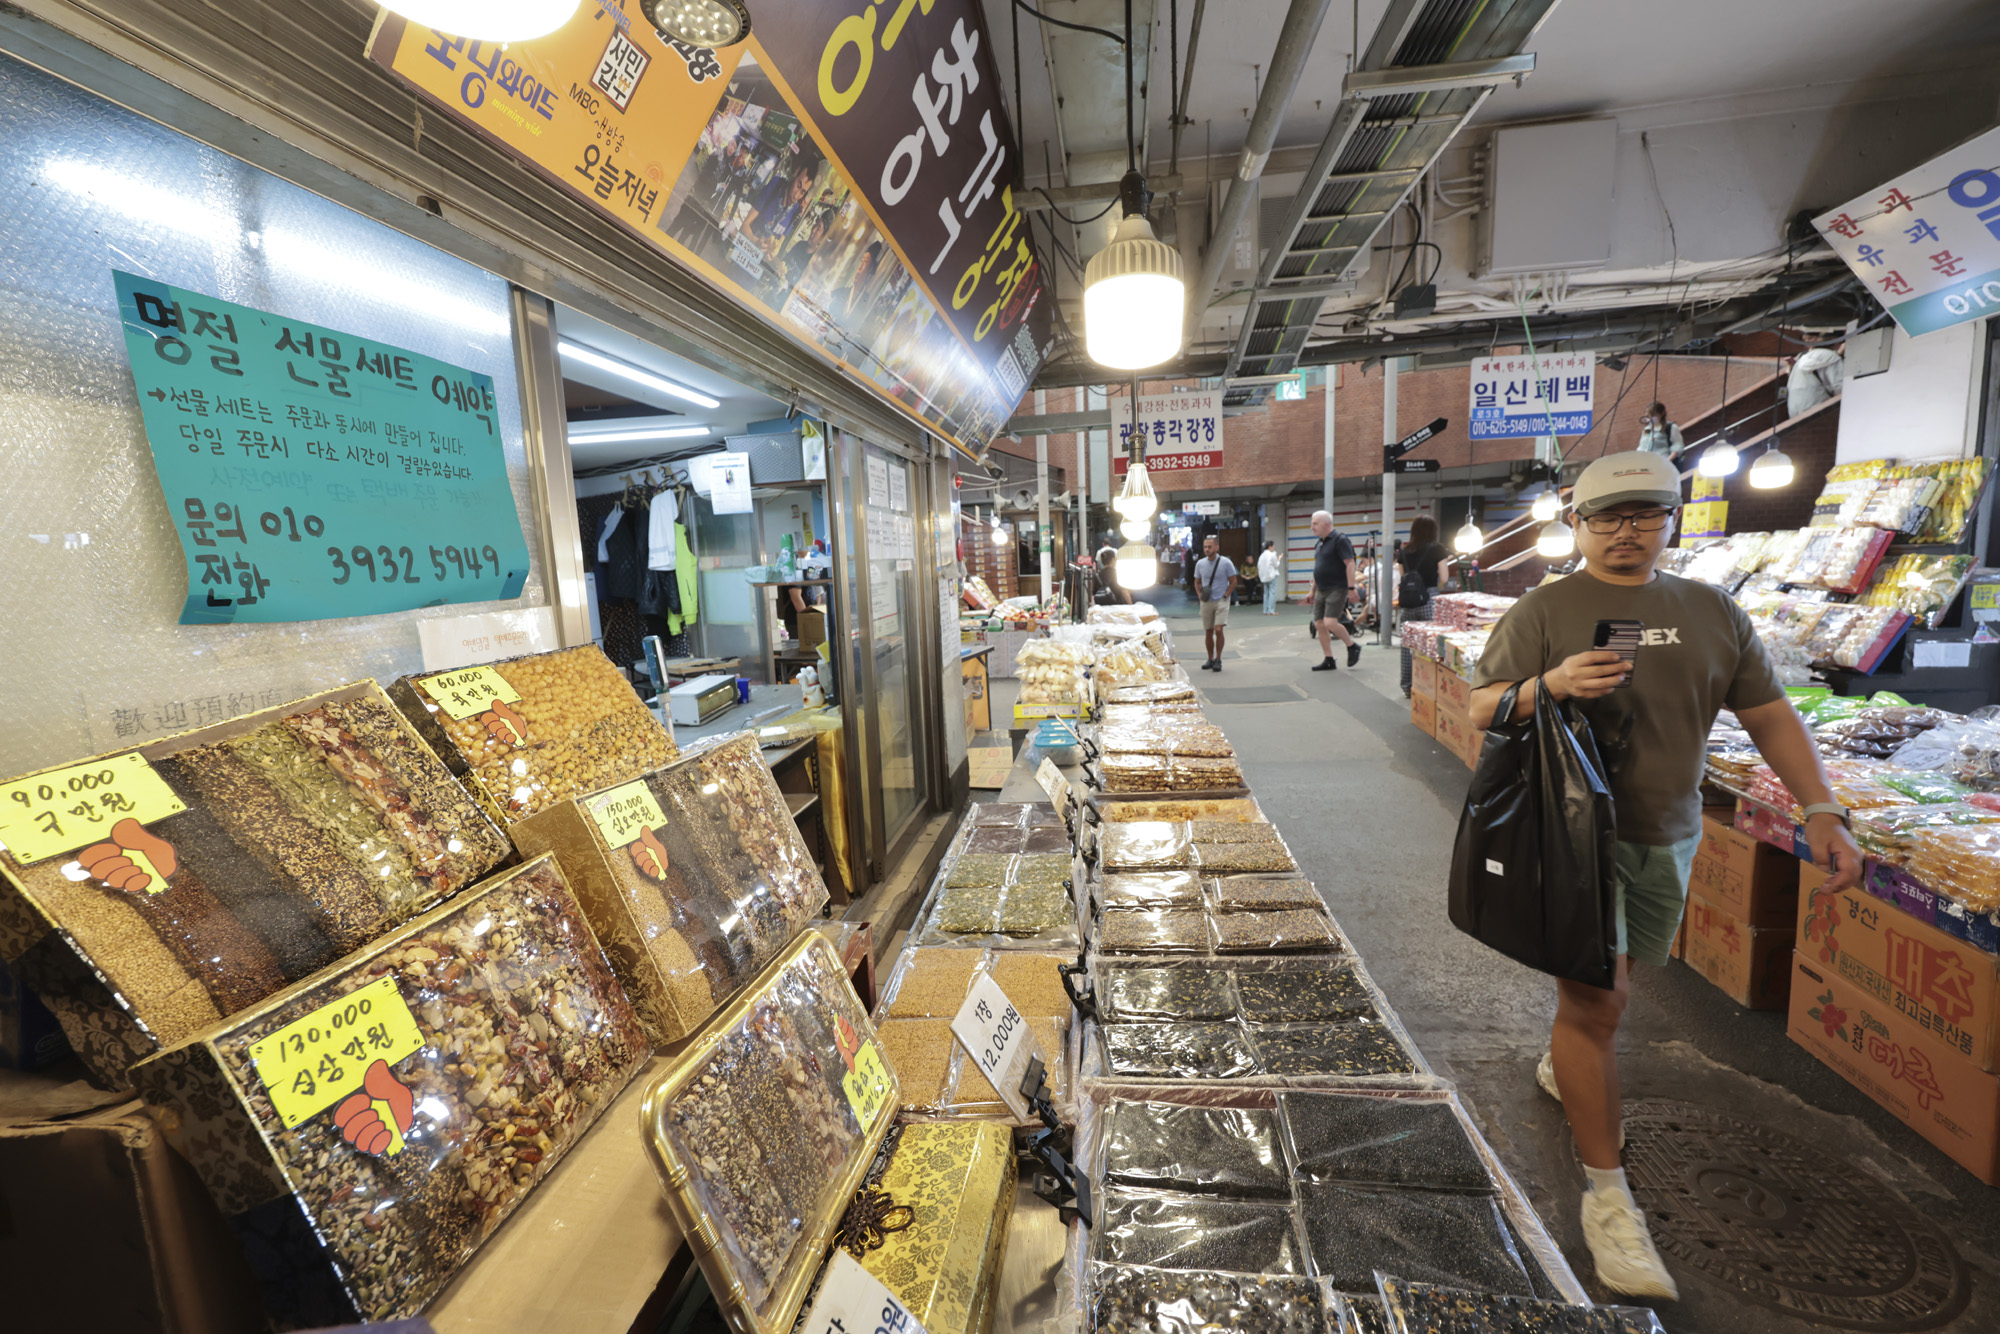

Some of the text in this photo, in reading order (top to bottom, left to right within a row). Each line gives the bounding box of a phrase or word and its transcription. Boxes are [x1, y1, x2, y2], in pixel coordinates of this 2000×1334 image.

[594, 0, 632, 34] HANNEL
[605, 36, 644, 81] 서민
[490, 96, 544, 138] morning wide
[568, 82, 600, 116] MBC
[594, 116, 626, 154] 생방송
[574, 143, 660, 224] 오늘저녁
[1828, 187, 1914, 229] 한과
[1856, 218, 1940, 267] 유과
[1877, 249, 1968, 296] 전문
[133, 291, 244, 377] 명절
[431, 374, 494, 436] 예약
[1474, 375, 1590, 408] 일신폐백
[179, 423, 226, 457] 당일
[236, 429, 290, 460] 주문시
[306, 440, 340, 462] 다소
[346, 445, 391, 469] 시간이
[284, 403, 331, 430] 주문과
[335, 413, 377, 436] 동시에
[384, 421, 423, 448] 만들어
[184, 497, 326, 546] 문의 010
[194, 544, 500, 607] 전화 3932 5949
[436, 671, 483, 689] 60,000
[11, 769, 115, 808] 90,000
[606, 795, 643, 818] 150,000
[1842, 894, 1880, 932] 경산
[1886, 928, 1974, 1023] 대추
[280, 999, 372, 1063] 130,000
[974, 998, 993, 1024] 1장
